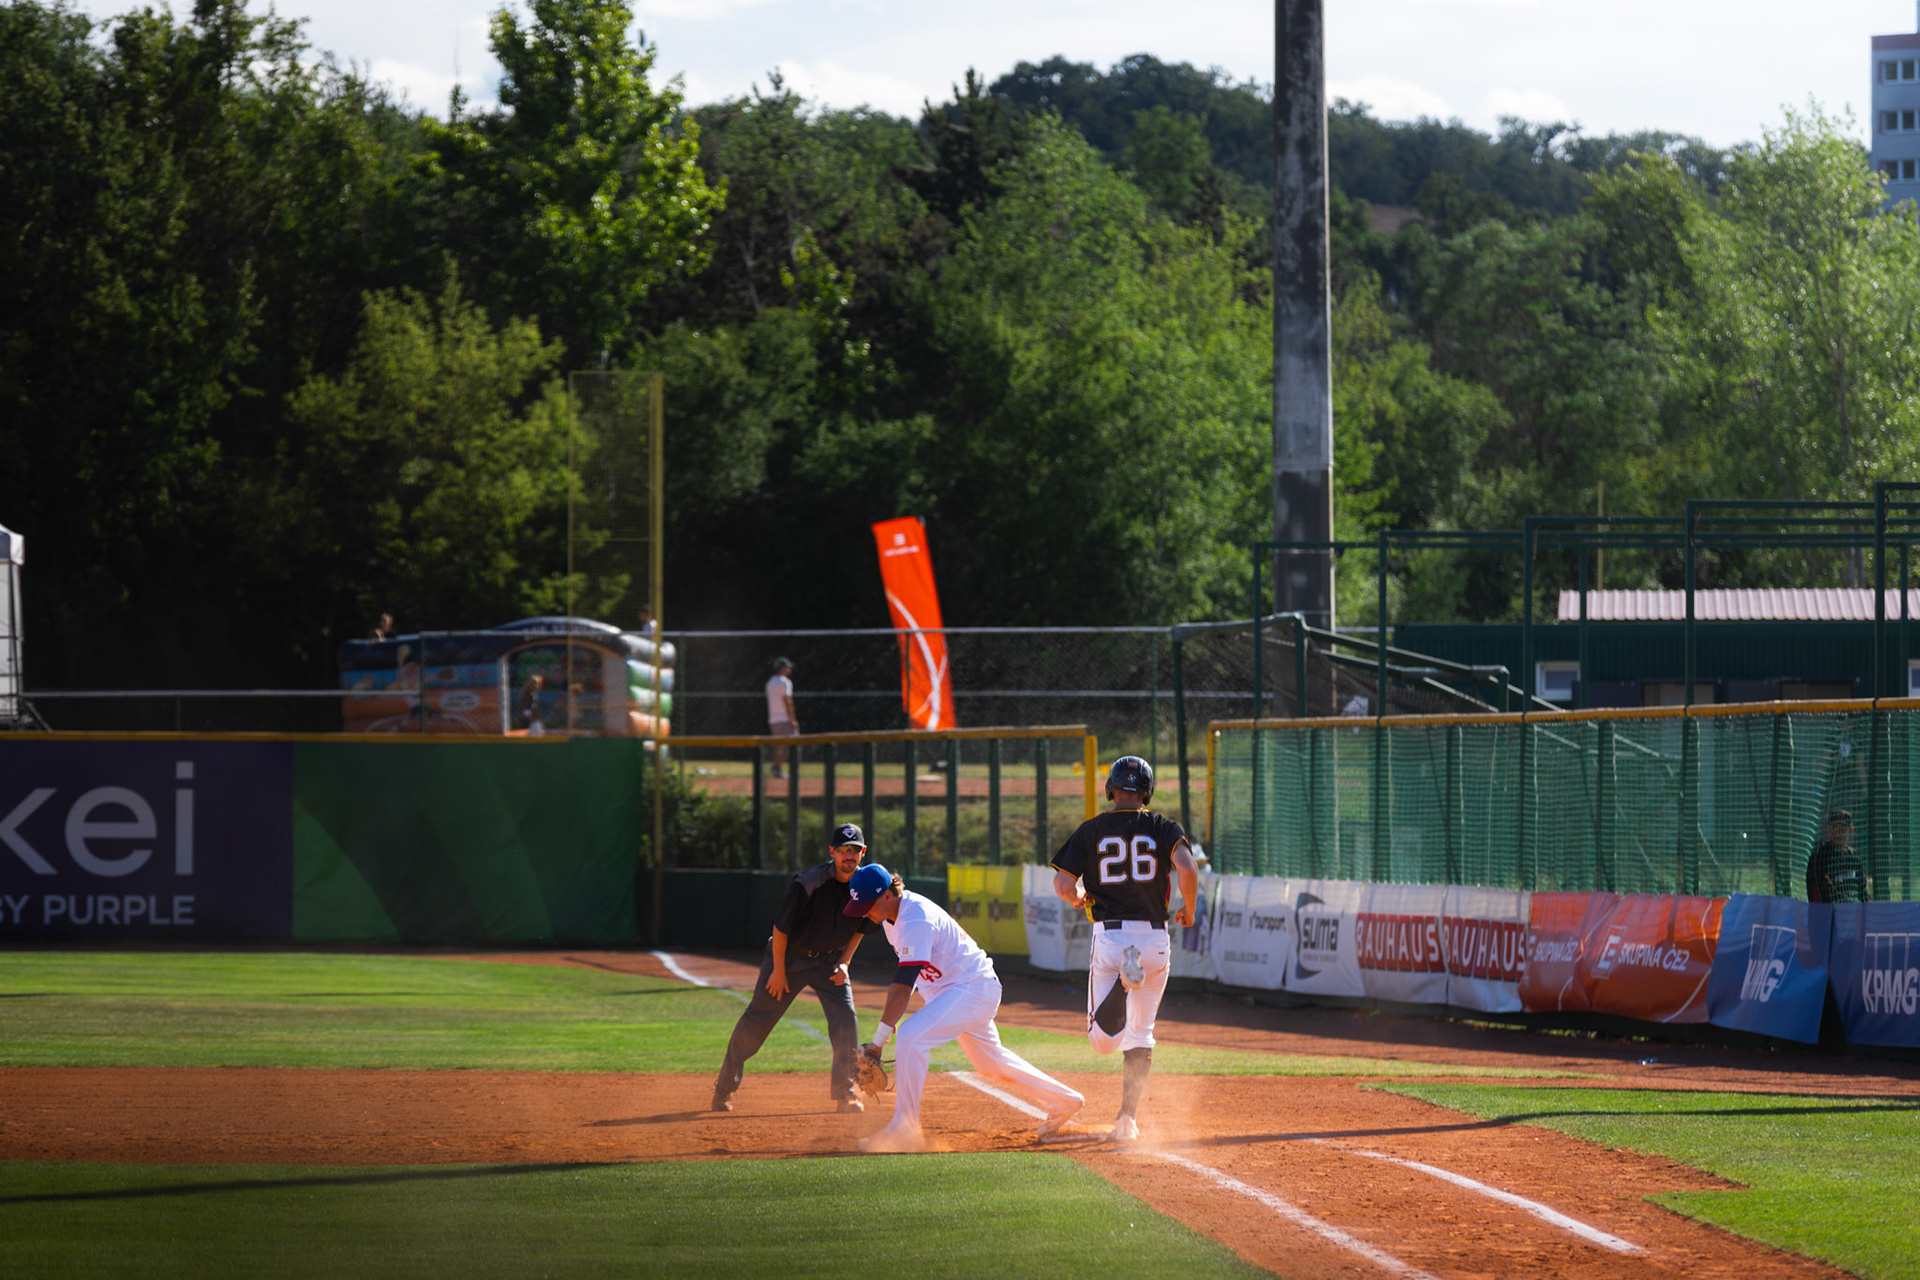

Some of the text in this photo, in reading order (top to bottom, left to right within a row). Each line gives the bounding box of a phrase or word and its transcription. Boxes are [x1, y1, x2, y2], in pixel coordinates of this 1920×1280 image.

[1097, 834, 1158, 885] 26
[0, 894, 196, 925] Y PURPLE
[1356, 920, 1439, 963] BAUHAUS
[1618, 942, 1663, 968] SKUPINA
[920, 964, 942, 983] 49
[1862, 968, 1920, 1015] KPMG
